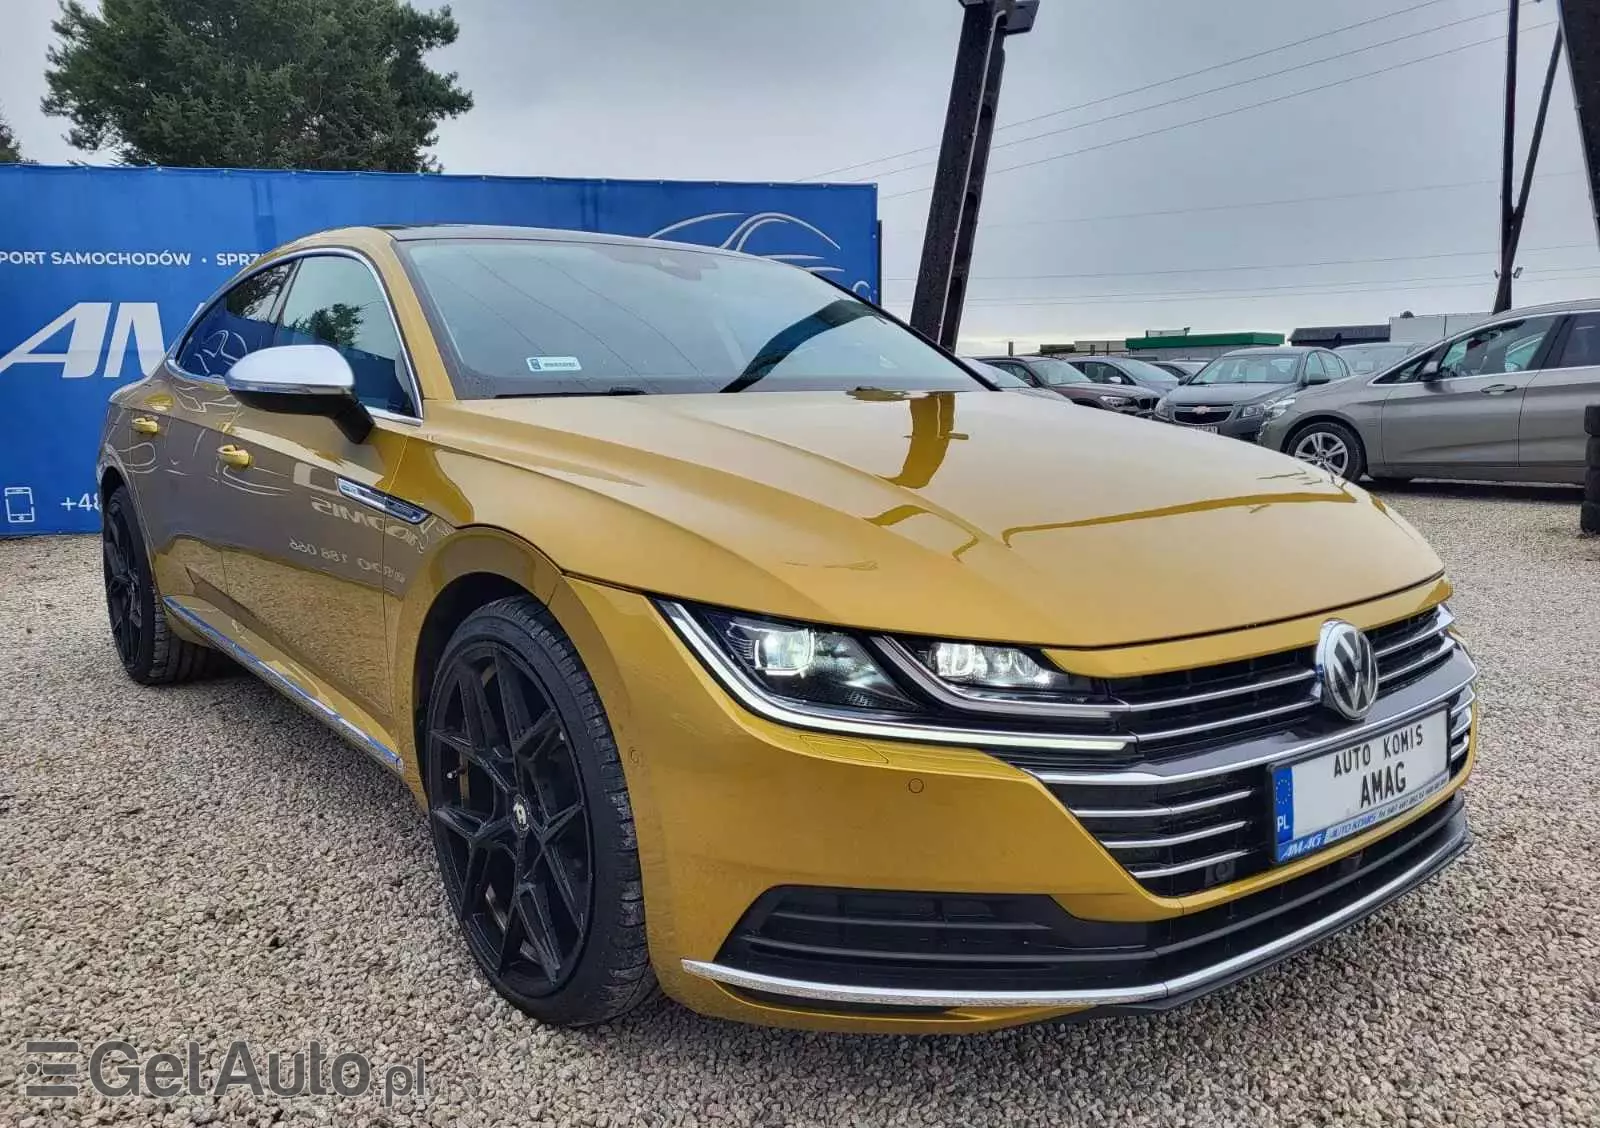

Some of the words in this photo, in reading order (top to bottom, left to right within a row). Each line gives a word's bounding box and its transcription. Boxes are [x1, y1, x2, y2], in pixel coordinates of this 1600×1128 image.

[51, 248, 192, 266] SAMOCHODÓW
[1333, 743, 1371, 779] AUTO
[1383, 723, 1424, 759] KOMIS
[1360, 761, 1407, 809] AMAG
[1277, 815, 1290, 832] PL
